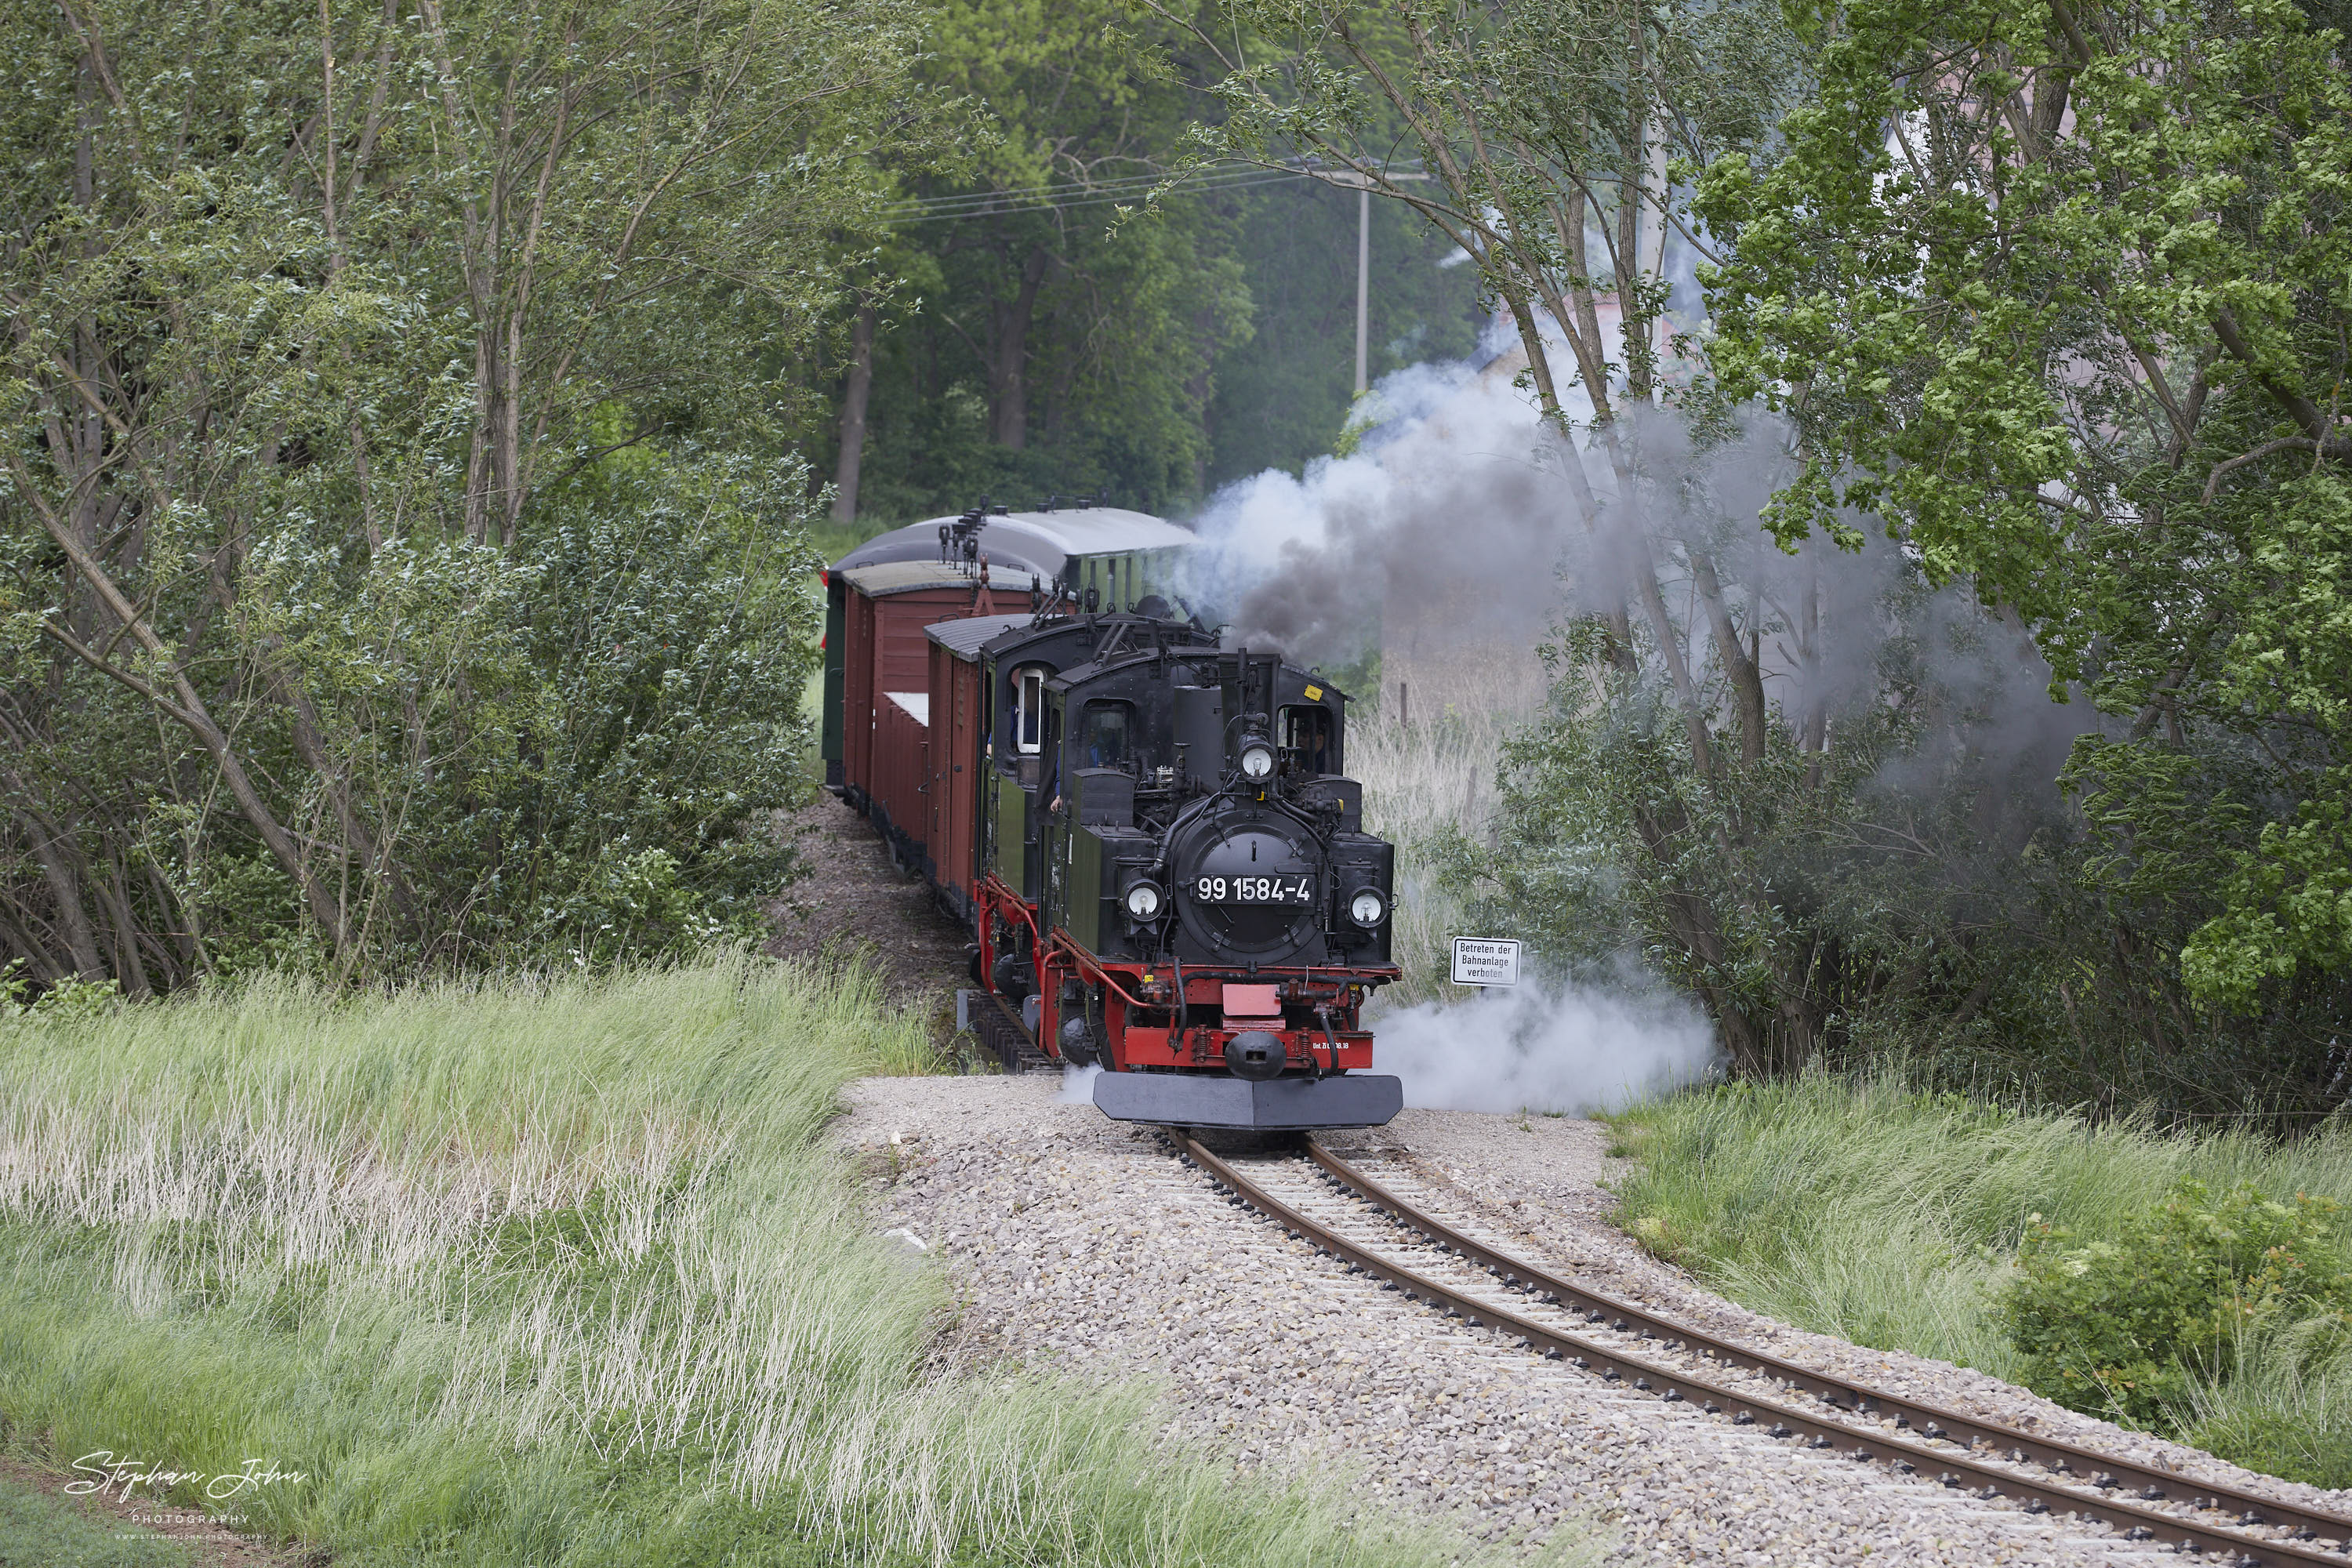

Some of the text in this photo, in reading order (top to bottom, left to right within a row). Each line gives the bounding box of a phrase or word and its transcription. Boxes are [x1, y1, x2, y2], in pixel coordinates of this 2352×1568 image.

[1198, 877, 1310, 901] 99 1584-4
[1460, 942, 1512, 954] Betreten der
[1462, 955, 1509, 968] Bahnanlage
[1467, 967, 1503, 978] verboten
